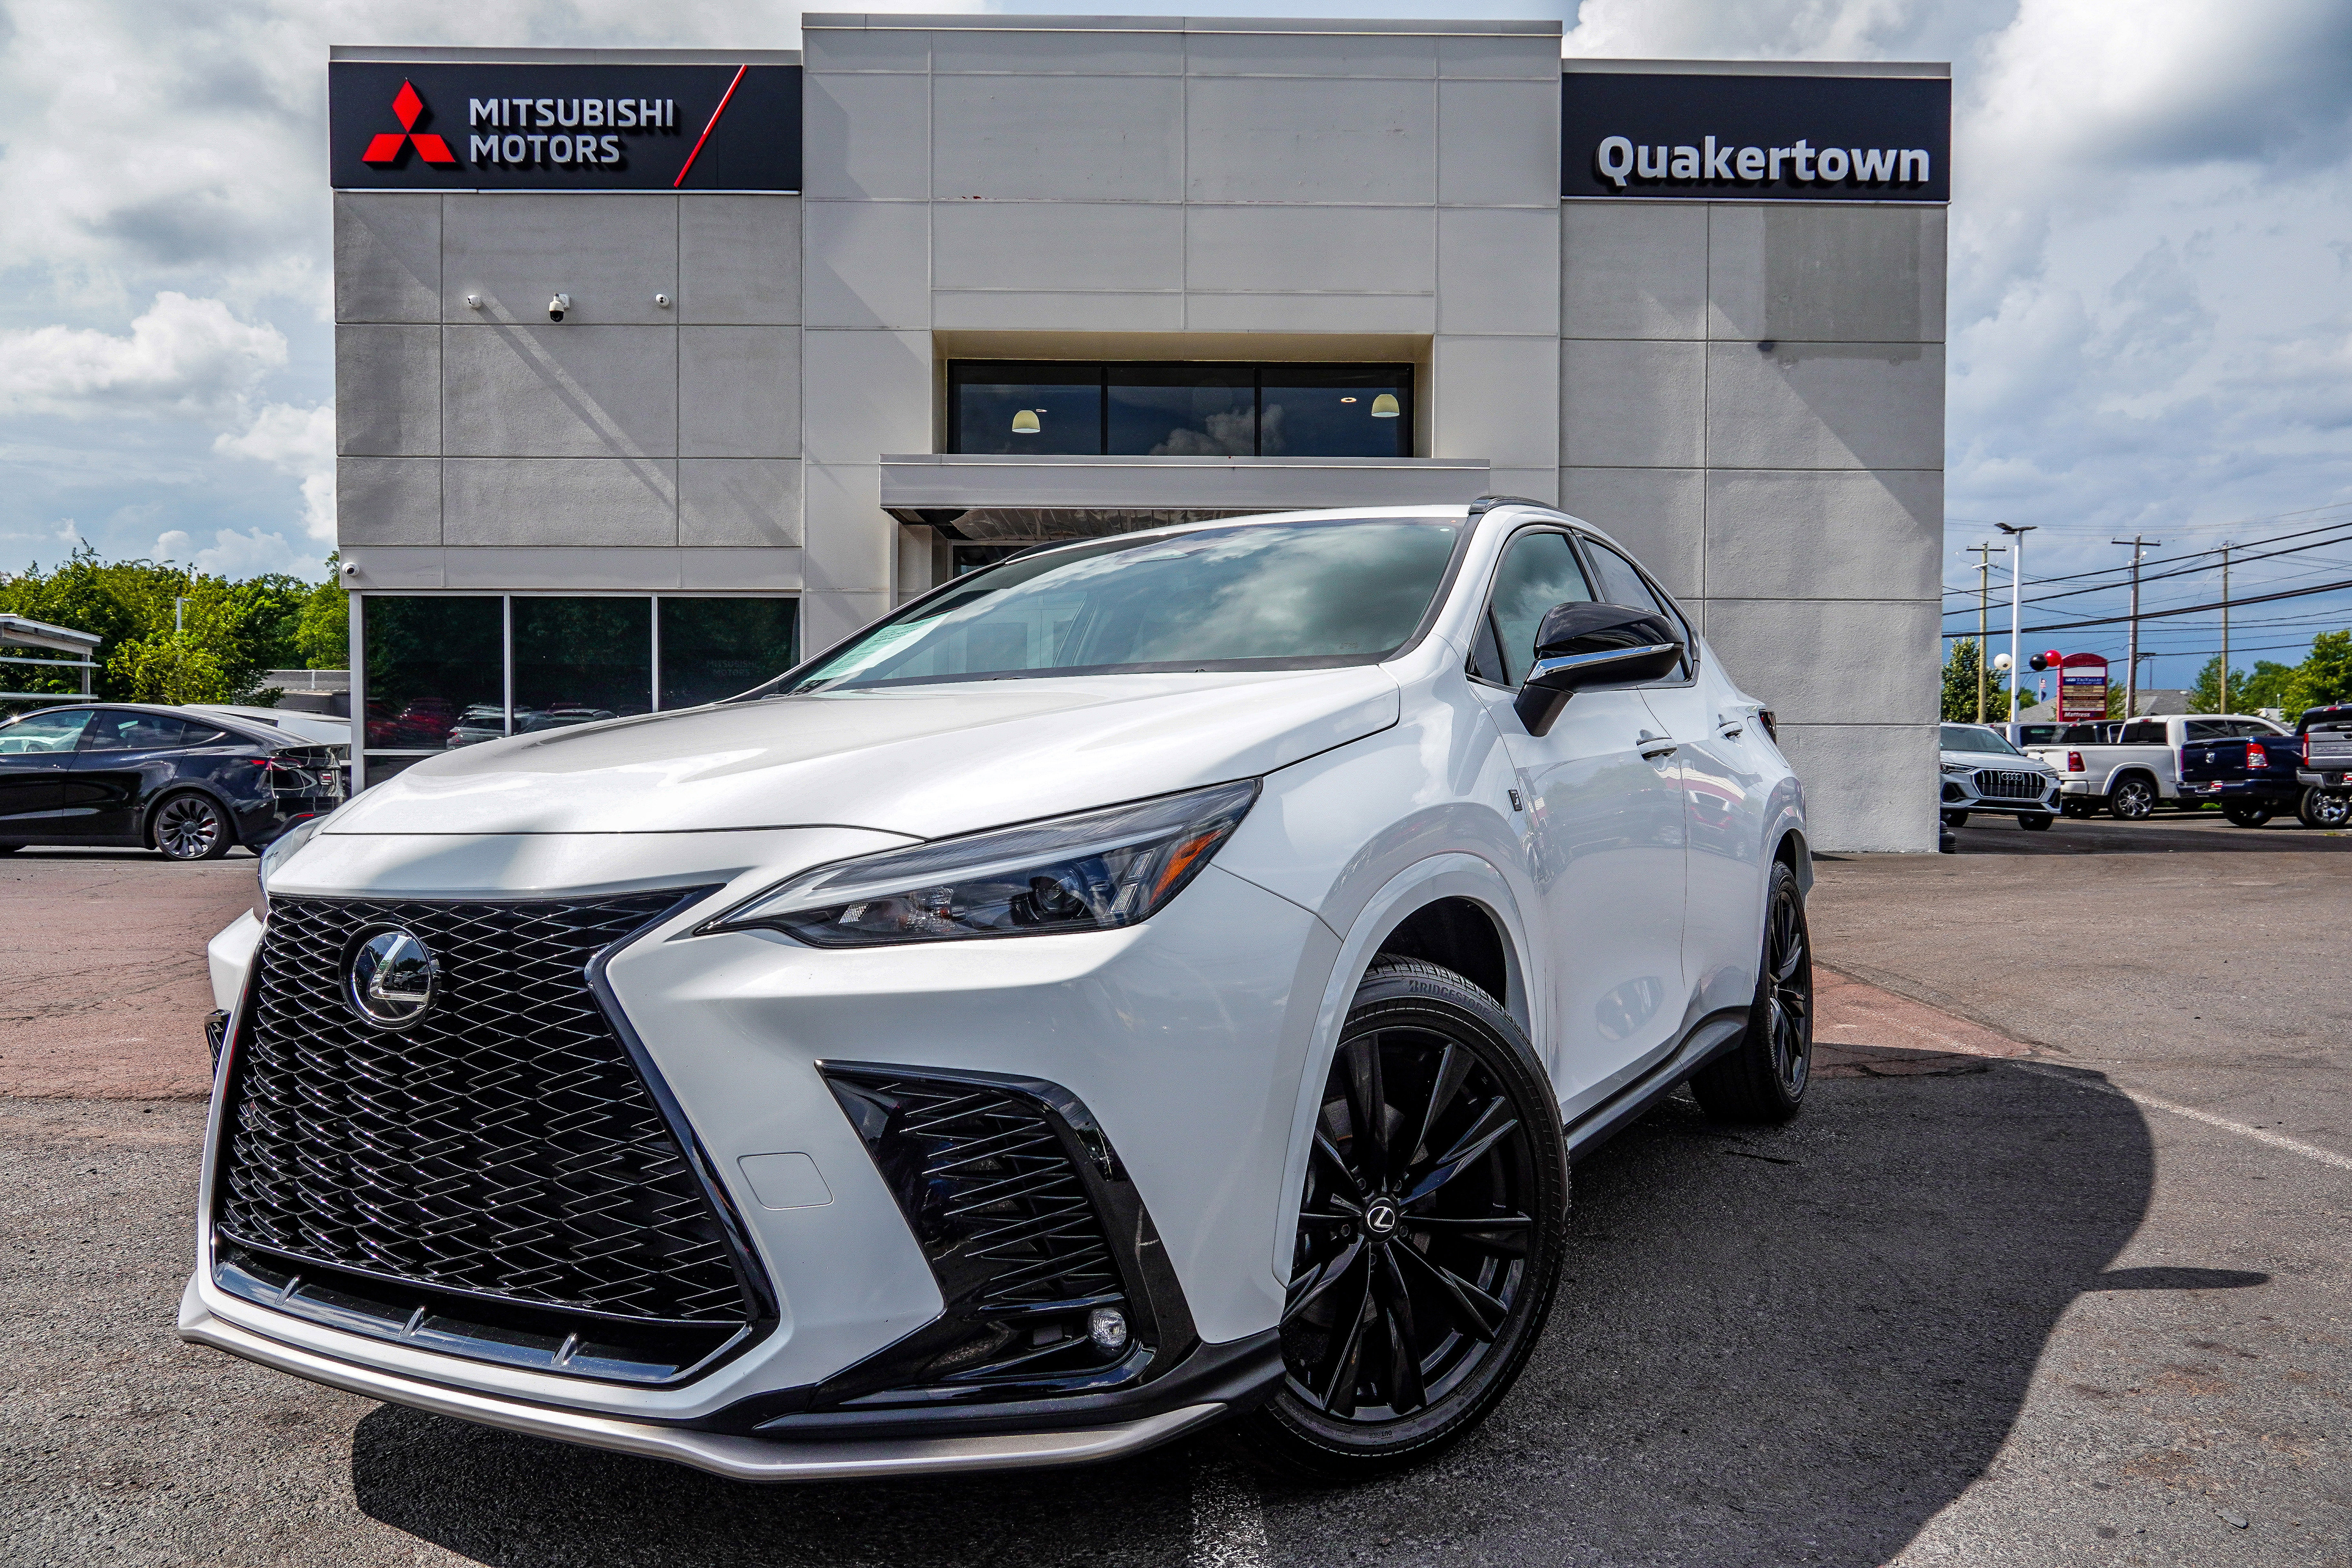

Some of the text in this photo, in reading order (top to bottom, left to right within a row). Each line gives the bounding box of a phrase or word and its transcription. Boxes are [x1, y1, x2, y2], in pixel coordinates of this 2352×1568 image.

[470, 99, 673, 127] MITSUBISHI
[470, 135, 619, 163] MOTORS
[1597, 136, 1930, 187] Quakertown
[1409, 980, 1490, 1017] BRIDGESTONE
